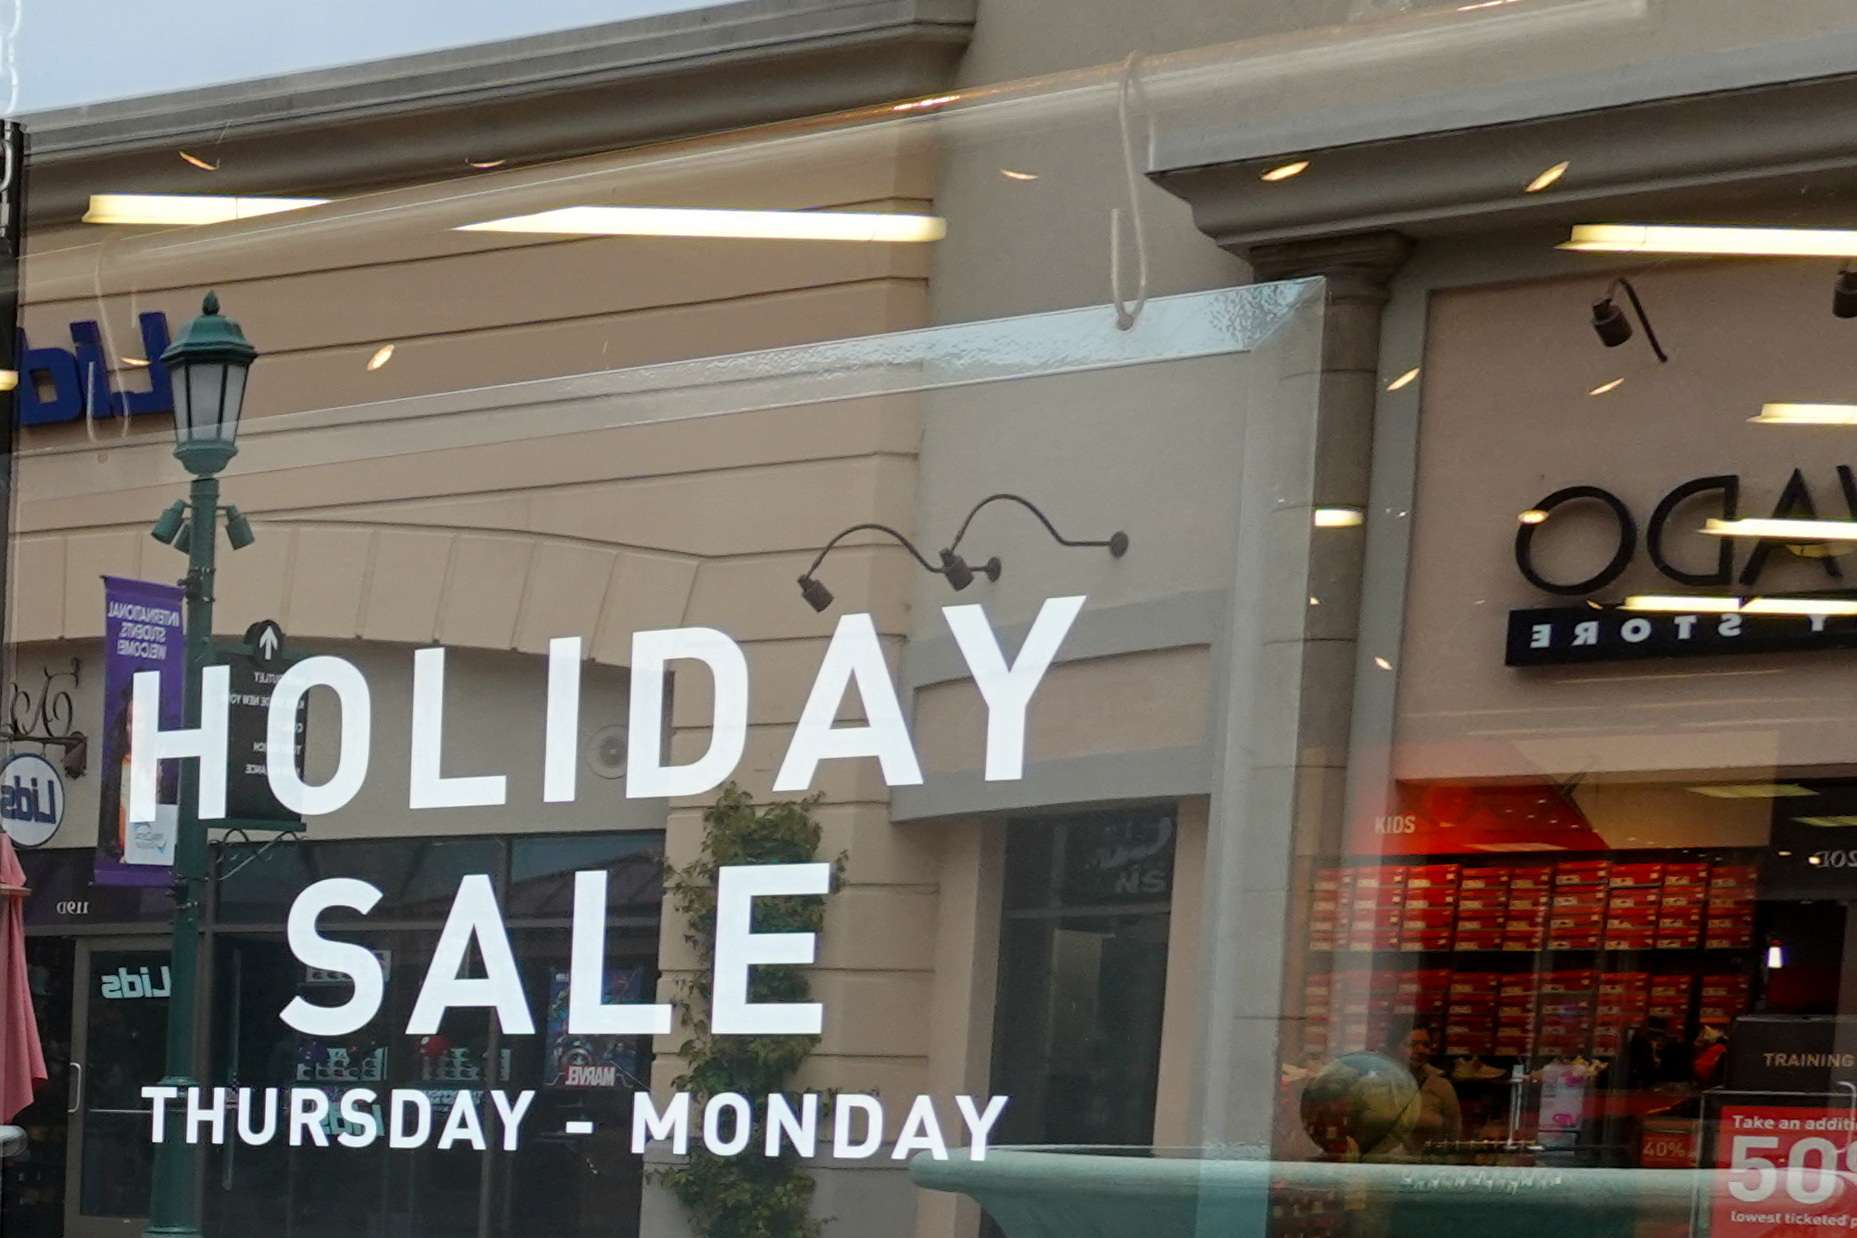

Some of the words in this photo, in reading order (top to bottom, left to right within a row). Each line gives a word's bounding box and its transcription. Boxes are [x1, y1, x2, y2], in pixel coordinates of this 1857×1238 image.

[128, 594, 1087, 824] HOLIDAY
[1374, 815, 1416, 835] KIDS
[276, 860, 837, 1037] SALE
[1764, 1052, 1855, 1068] TRAINING
[141, 1085, 537, 1151] THURSDAY
[630, 1090, 1010, 1163] MONDAY
[1732, 1115, 1776, 1129] Take
[1778, 1119, 1800, 1130] an
[1727, 1135, 1857, 1205] 50
[1731, 1210, 1781, 1224] lowest
[1785, 1213, 1847, 1227] ticketed
